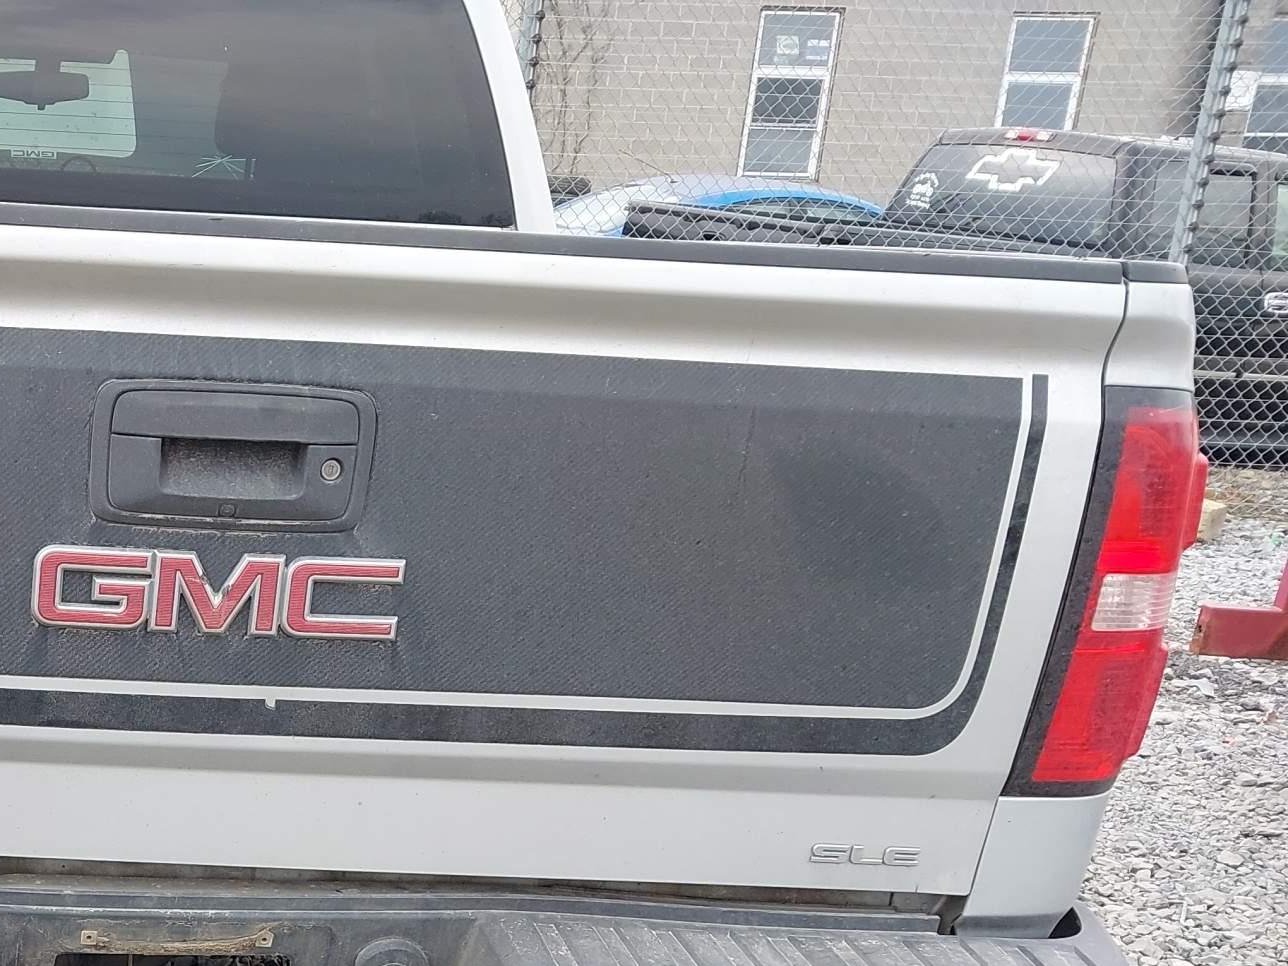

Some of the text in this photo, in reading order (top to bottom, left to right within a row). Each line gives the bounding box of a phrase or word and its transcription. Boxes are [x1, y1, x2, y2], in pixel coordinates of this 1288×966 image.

[12, 149, 55, 158] GMC
[31, 544, 406, 642] GMC
[809, 842, 921, 867] SLE
